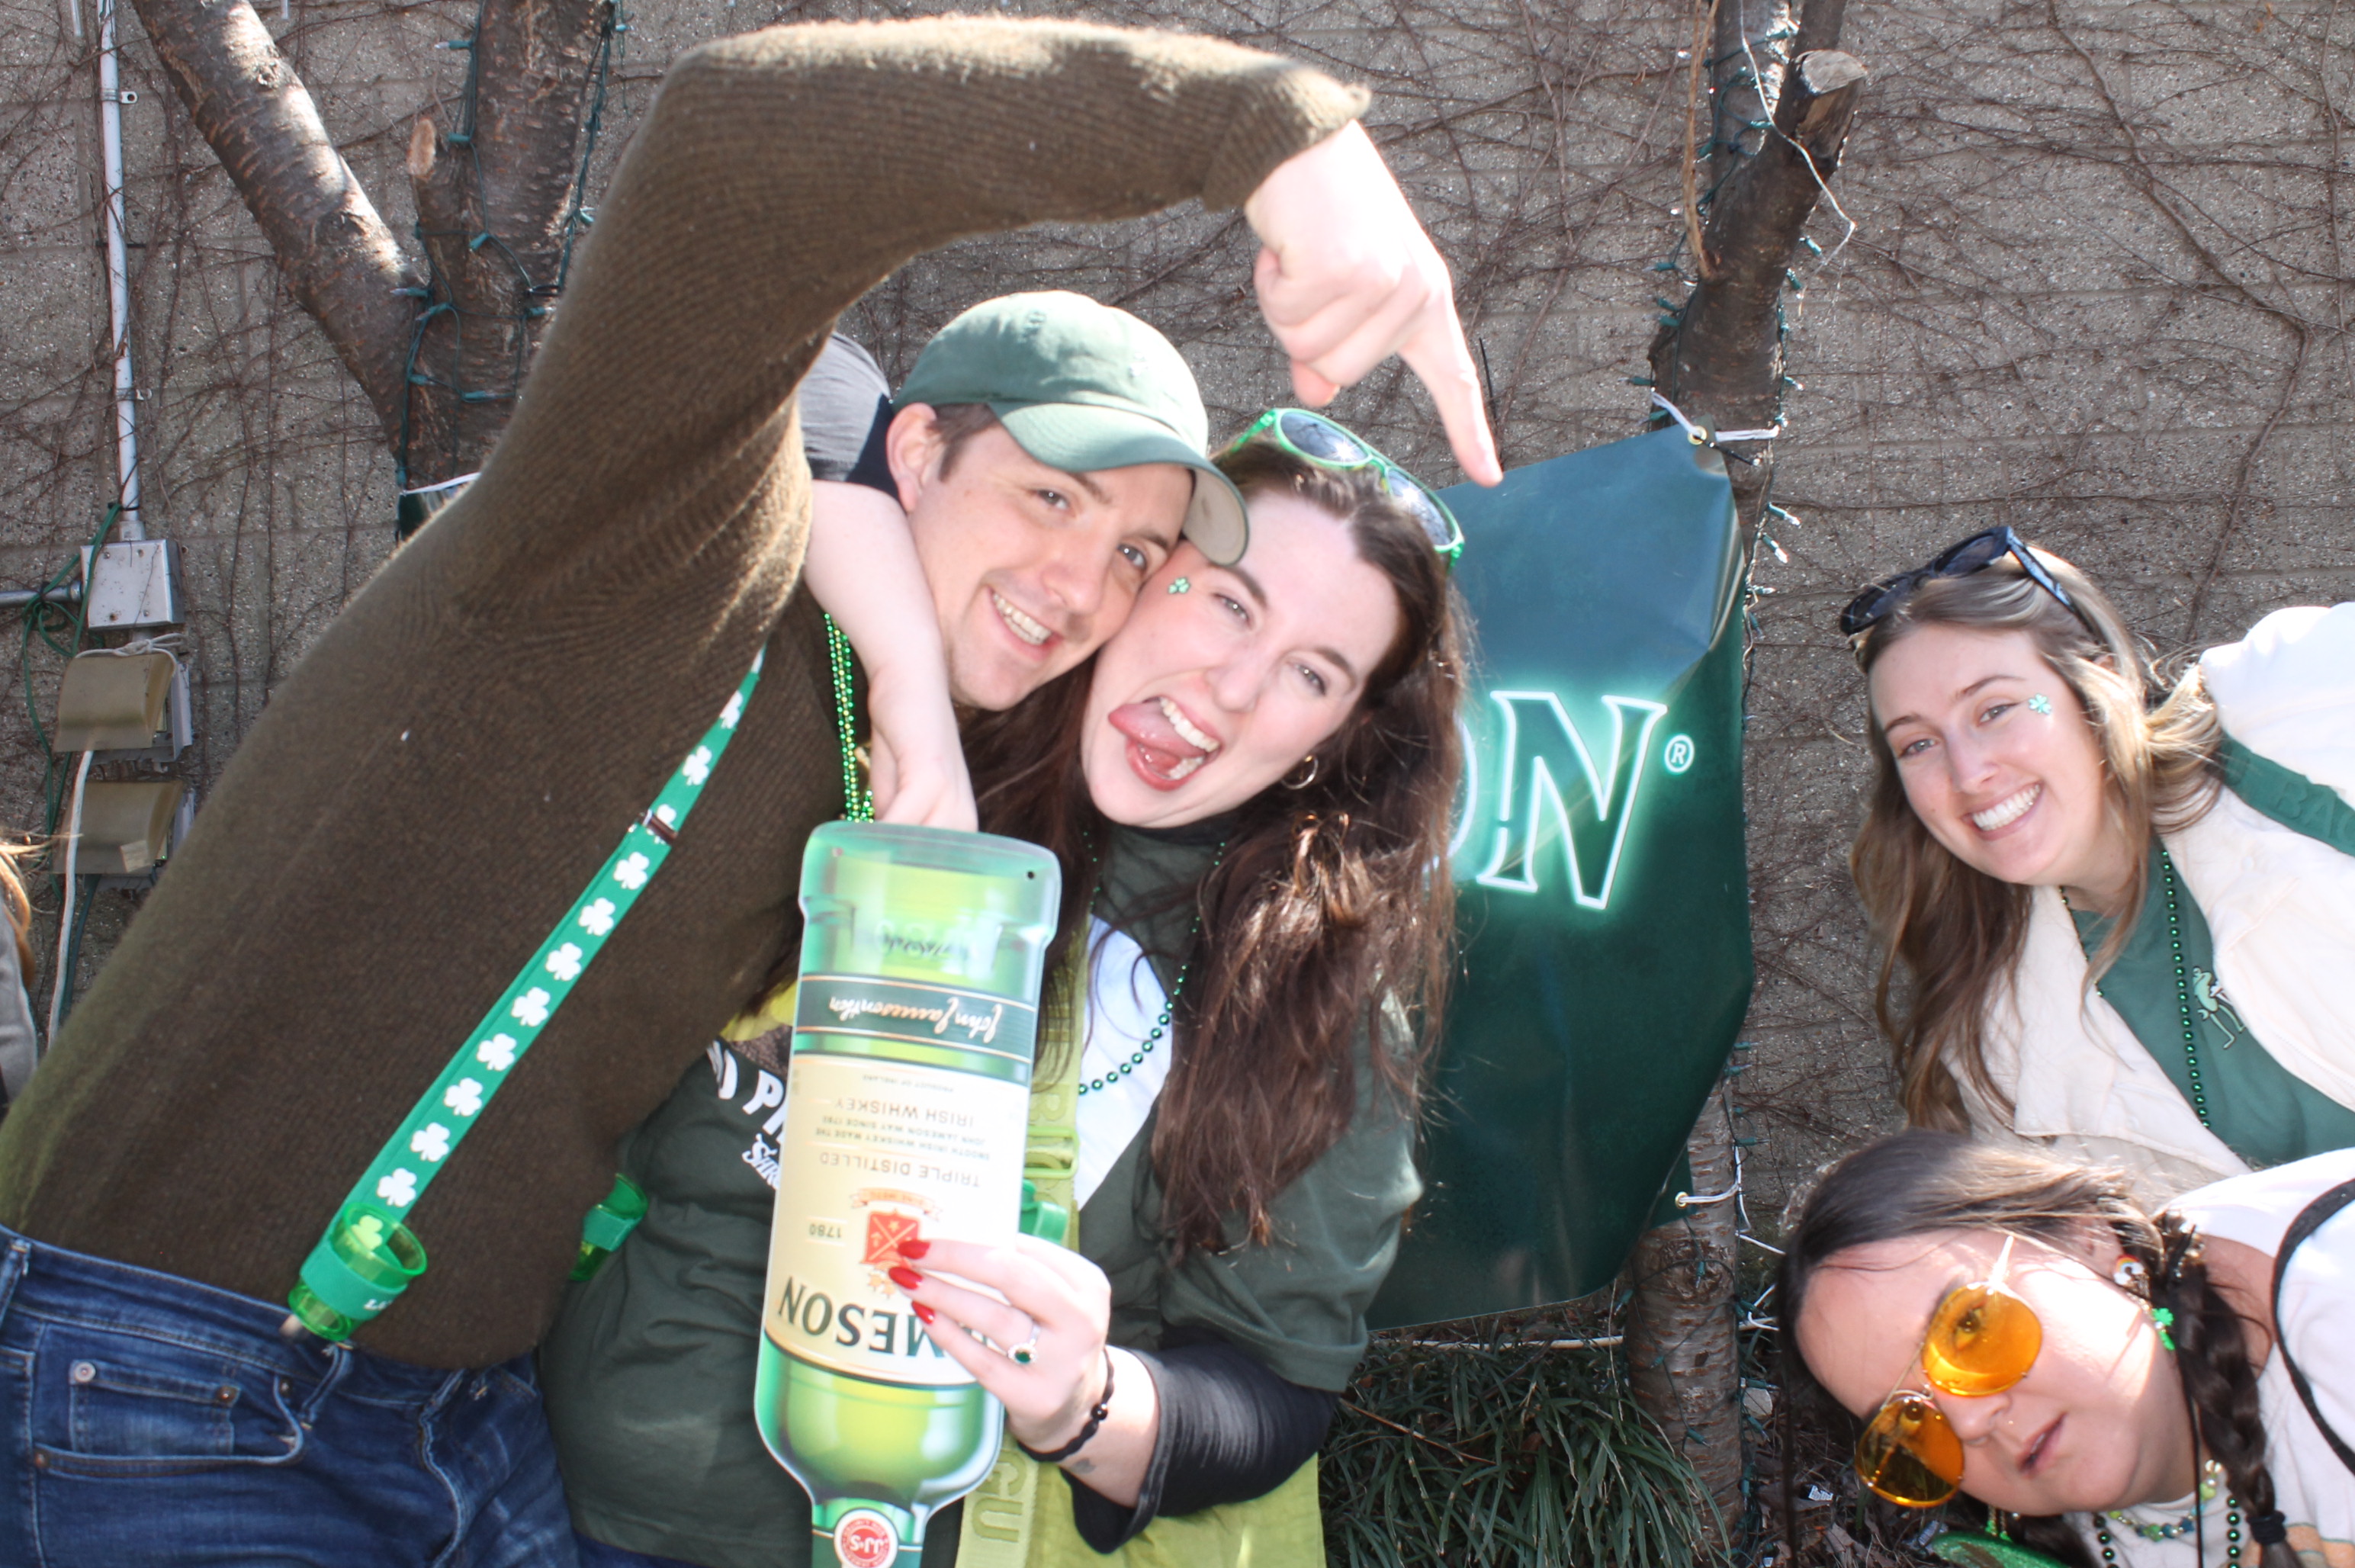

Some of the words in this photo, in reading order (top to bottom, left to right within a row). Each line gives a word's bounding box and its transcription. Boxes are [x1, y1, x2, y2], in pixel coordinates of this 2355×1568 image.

[836, 1097, 918, 1120] WHISKEY
[847, 1118, 876, 1129] SINCE
[926, 1109, 974, 1128] IRISH
[815, 1127, 831, 1137] THE
[836, 1129, 862, 1140] MADE
[881, 1123, 903, 1133] WAY
[908, 1127, 958, 1141] JAMESON
[866, 1134, 915, 1147] WHISKEY
[919, 1142, 949, 1153] IRISH
[820, 1152, 911, 1176] DISTILLED
[918, 1165, 980, 1187] TRIPLE
[808, 1222, 843, 1239] 1780
[778, 1275, 988, 1358] MESON
